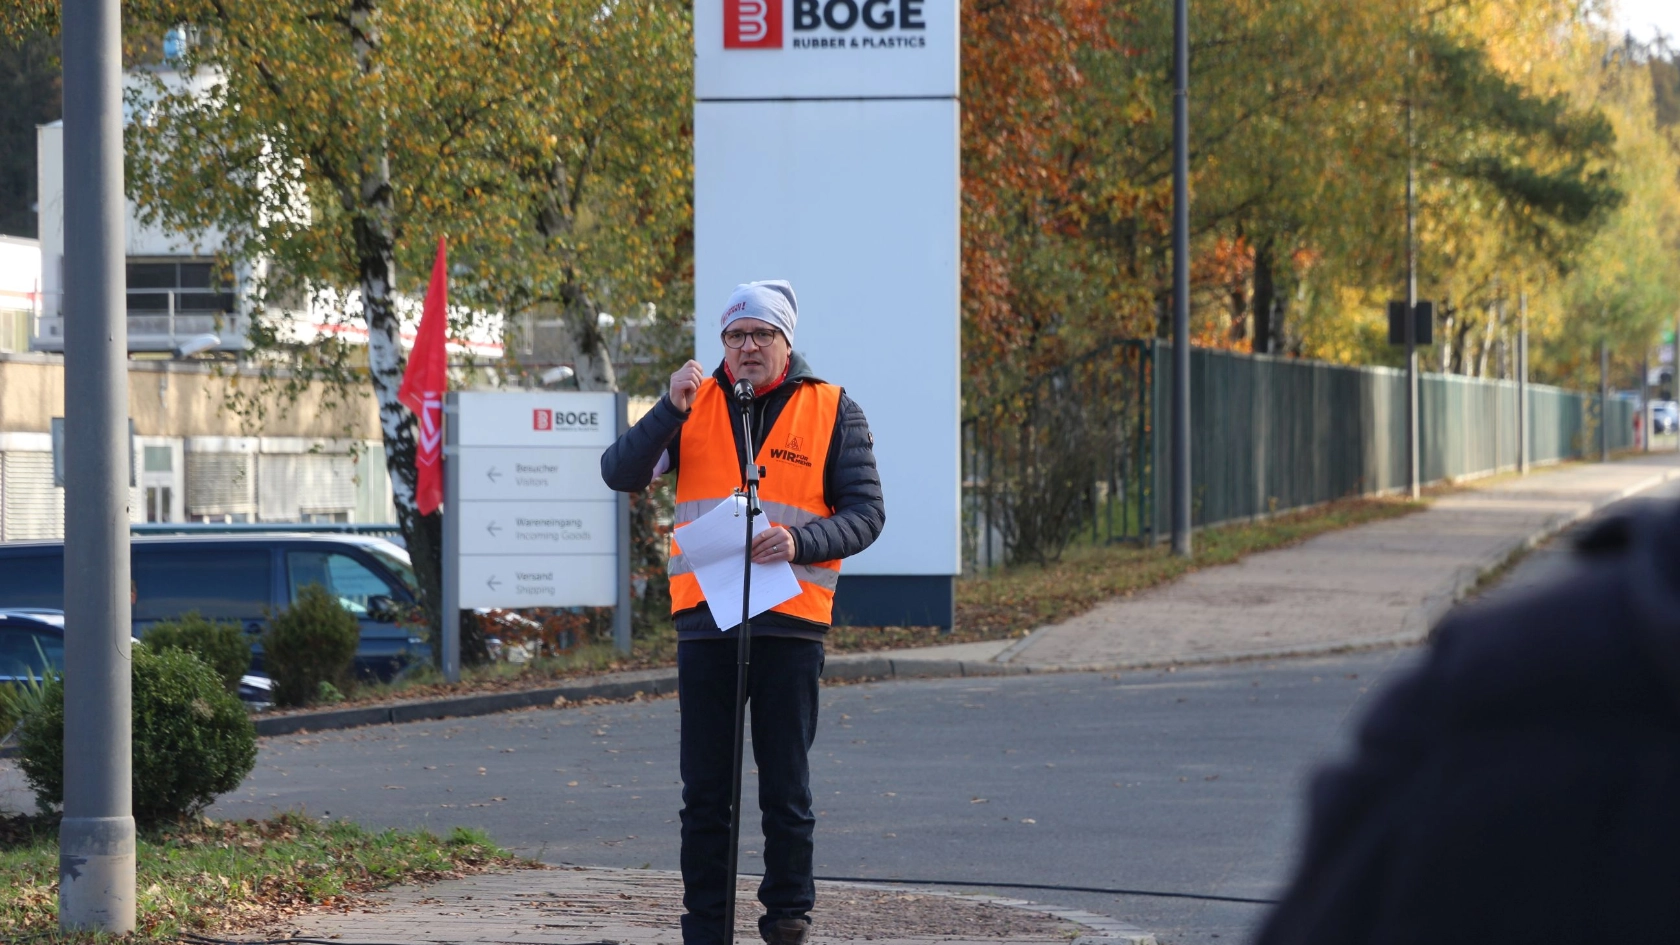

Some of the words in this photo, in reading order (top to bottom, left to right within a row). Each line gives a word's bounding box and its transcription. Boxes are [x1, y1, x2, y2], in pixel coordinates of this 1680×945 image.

[793, 0, 926, 31] BOGE
[793, 37, 846, 48] RUBBER
[850, 37, 859, 48] &
[862, 37, 926, 48] PLASTICS
[555, 411, 599, 425] BOGE
[770, 448, 797, 462] WIR
[515, 463, 558, 474] Besucher
[516, 478, 549, 487] Visitors
[515, 518, 583, 529] Wareneingang
[516, 531, 559, 542] Incoming
[561, 531, 591, 541] Goods
[515, 571, 554, 581] Versand
[516, 585, 556, 596] Shipping
